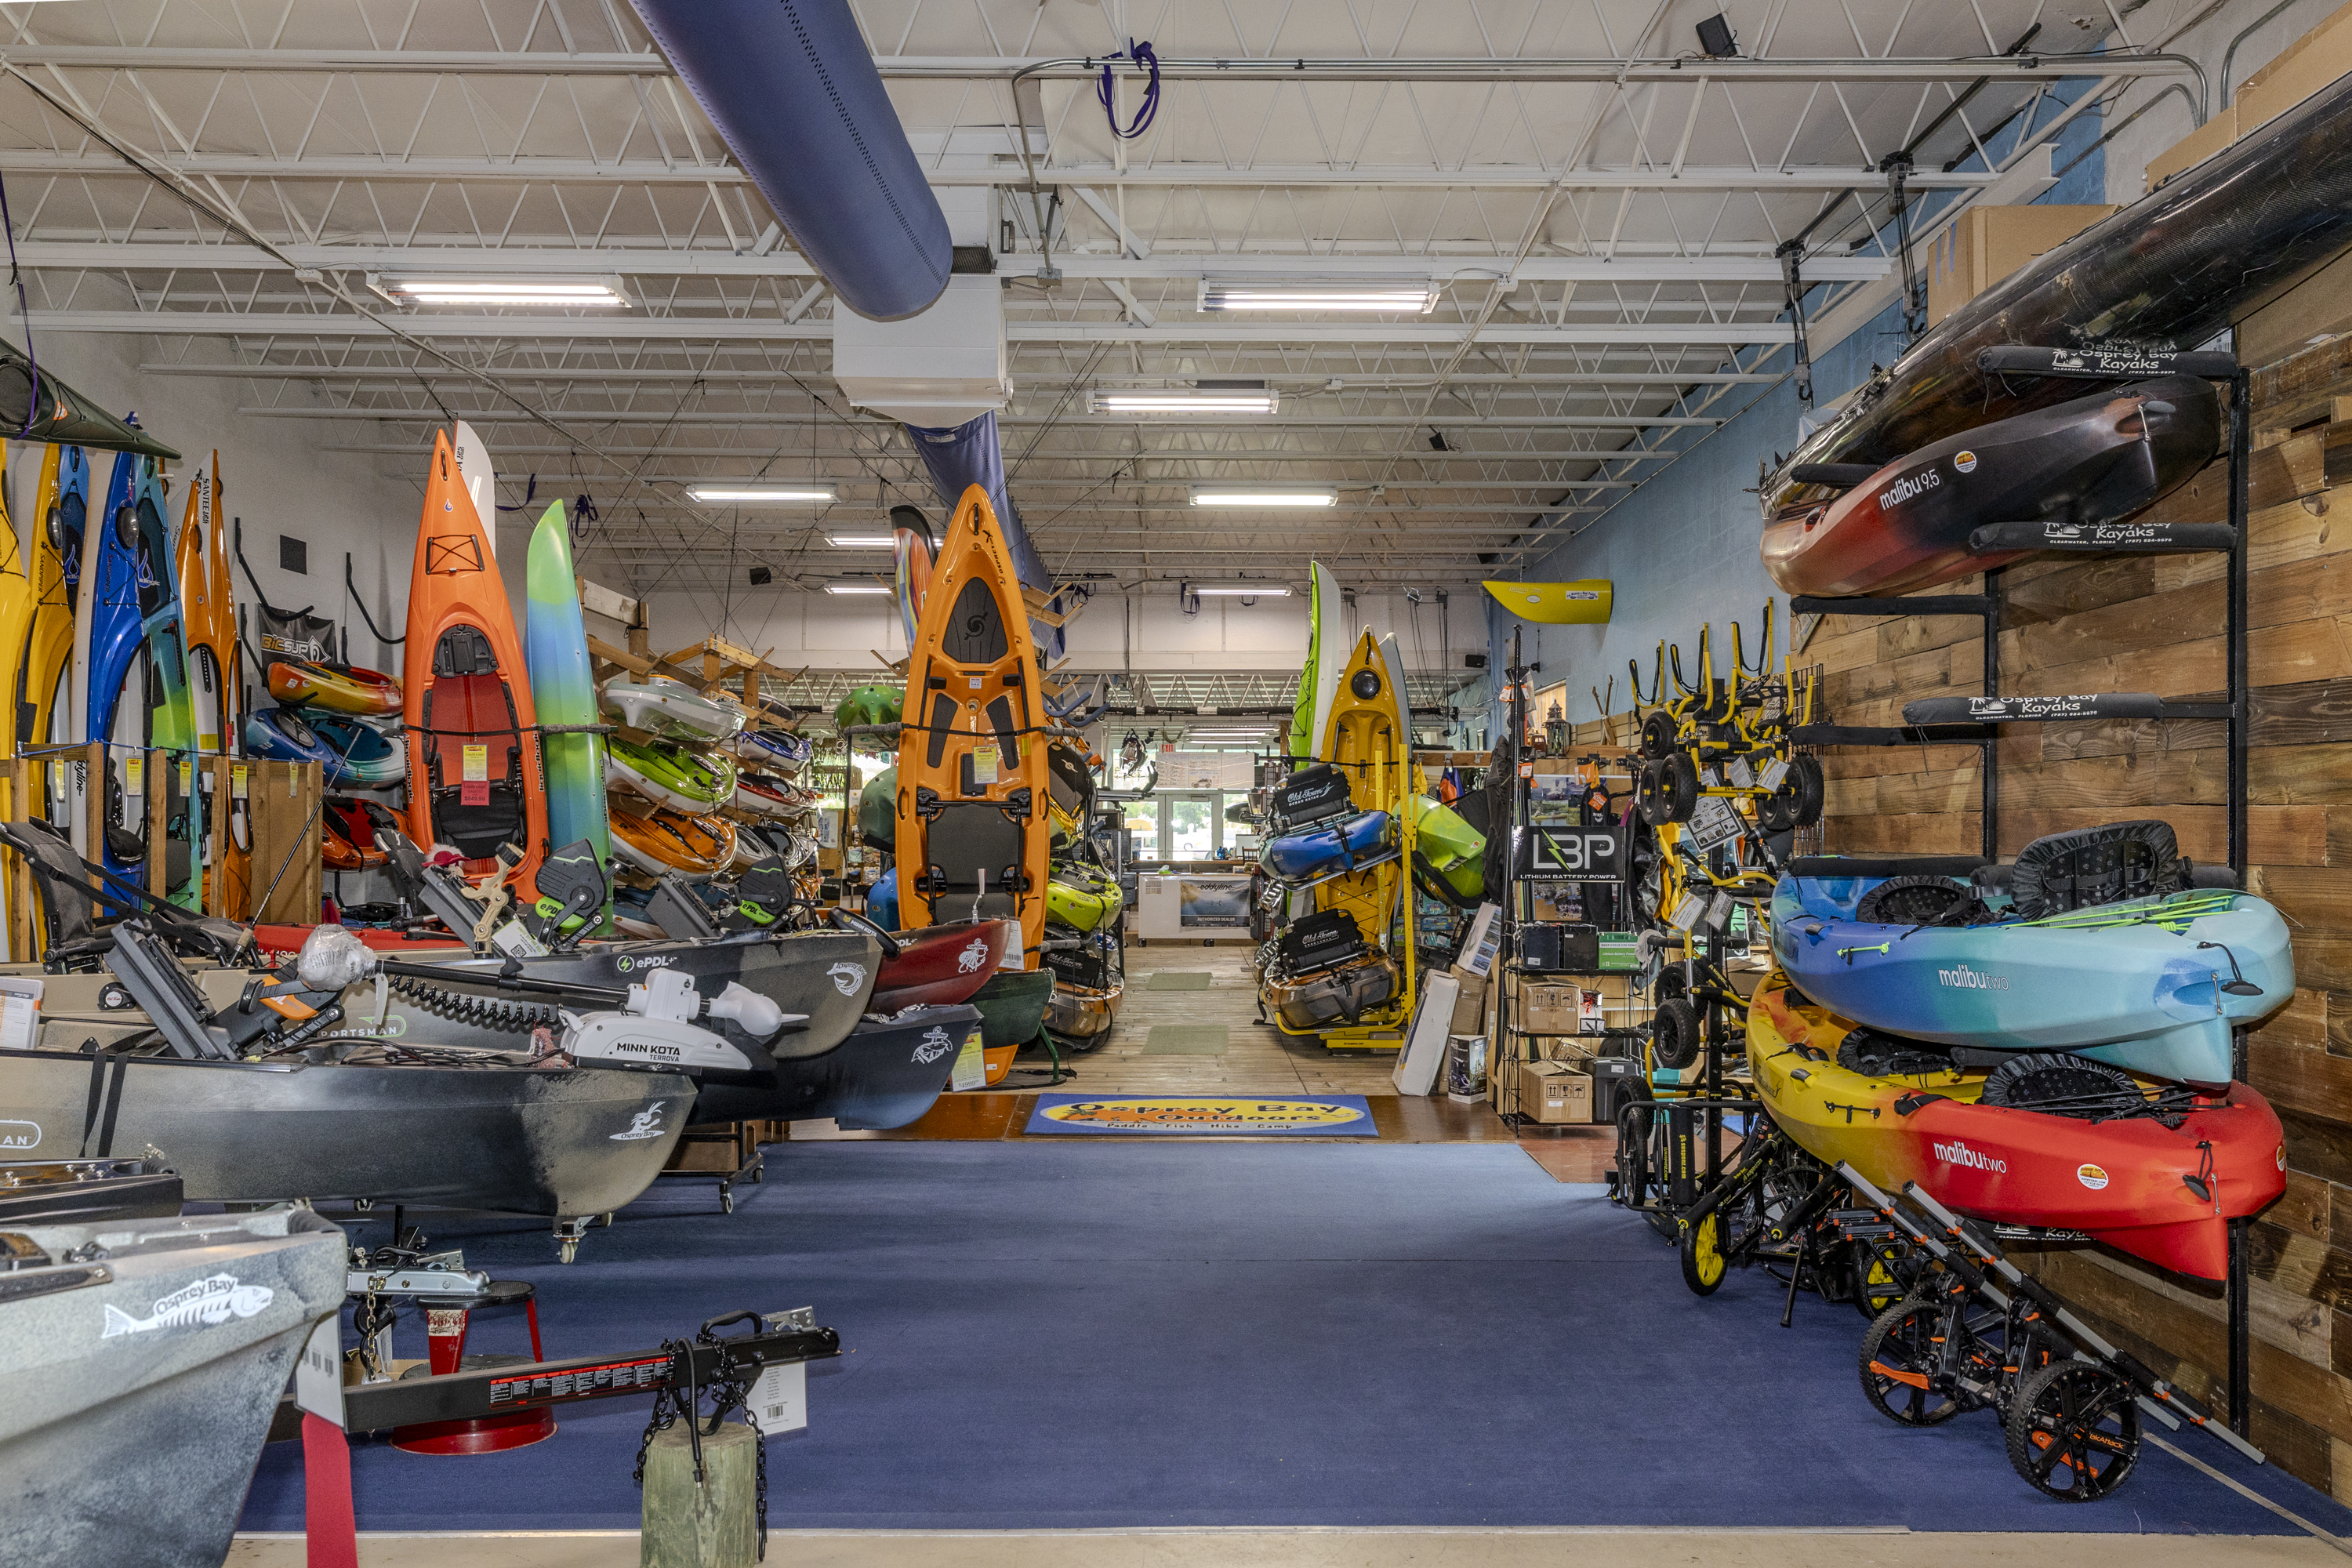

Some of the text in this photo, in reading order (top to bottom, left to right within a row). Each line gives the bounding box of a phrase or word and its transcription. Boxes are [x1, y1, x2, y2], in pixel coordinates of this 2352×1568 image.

[2079, 350, 2141, 361] Osprey
[2100, 358, 2159, 371] Kayaks
[1880, 469, 1940, 510] malibu 9.5
[2096, 528, 2154, 540] Kayaks
[990, 545, 1004, 574] OSPREY
[105, 554, 114, 593] SANDPIPER
[2000, 696, 2061, 705] Osprey
[2022, 701, 2081, 714] Kayaks
[1287, 787, 1323, 803] Old Town
[1533, 834, 1615, 869] LBP
[1198, 883, 1235, 892] eddyline
[540, 903, 561, 915] ePD
[742, 903, 759, 915] ePDL
[851, 920, 877, 938] MINN KOTA
[1302, 930, 1338, 945] Old Town
[857, 965, 866, 975] Bay
[1938, 964, 2009, 992] malibu two
[321, 1026, 397, 1037] PORTSMAN
[616, 1042, 681, 1056] MINN KOTA
[1070, 1103, 1341, 1114] Osprey Bay
[1157, 1113, 1321, 1122] Outdoors
[1933, 1140, 2007, 1174] malibu two
[2045, 1227, 2086, 1240] Kaya
[156, 1278, 237, 1315] Osprey Bay
[2089, 1433, 2124, 1450] akAttack
